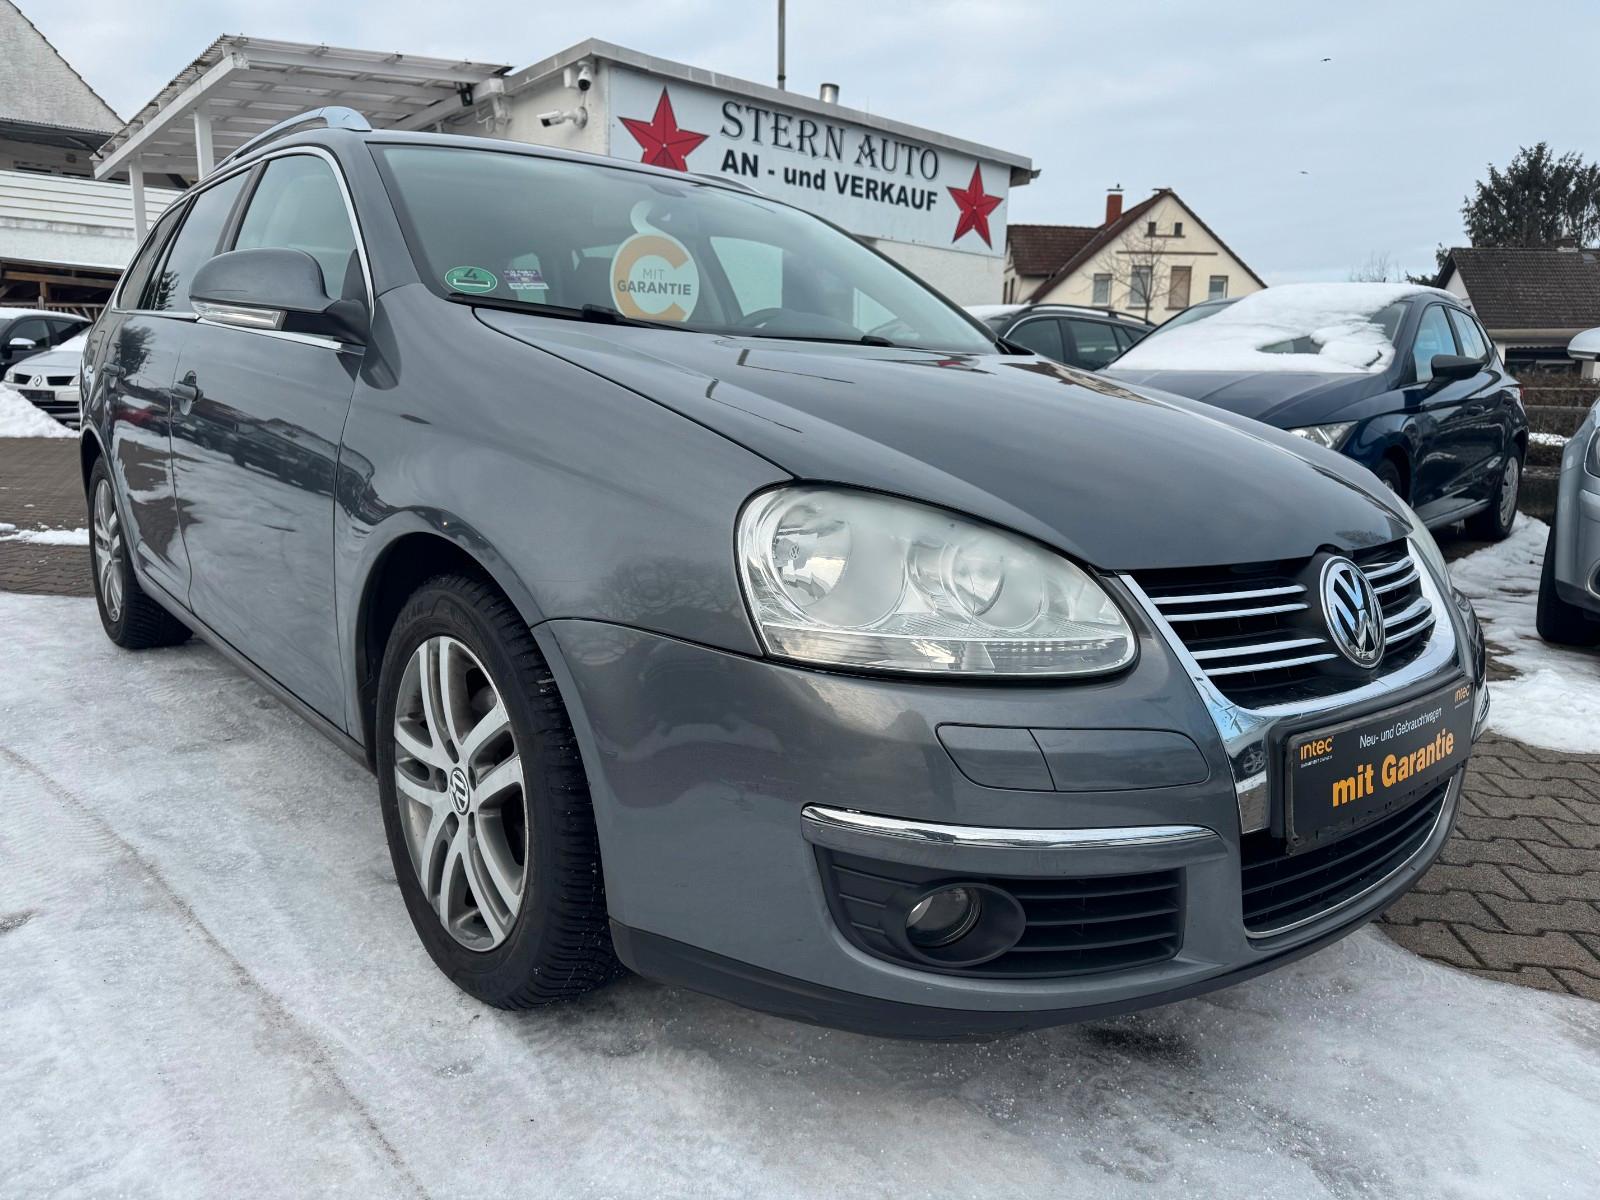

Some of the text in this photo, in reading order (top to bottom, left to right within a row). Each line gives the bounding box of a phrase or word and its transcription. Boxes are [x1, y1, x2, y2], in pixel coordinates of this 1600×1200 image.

[720, 100, 939, 181] STERN AUTO
[720, 148, 759, 178] AN
[783, 166, 826, 191] und
[834, 171, 938, 211] VERKAUF
[617, 279, 692, 296] GARANTIE
[642, 267, 665, 280] MIT
[1300, 736, 1333, 761] intec
[1360, 707, 1442, 749] Neu- und Gebrauchtwagen
[1332, 728, 1454, 808] mit Garantie
